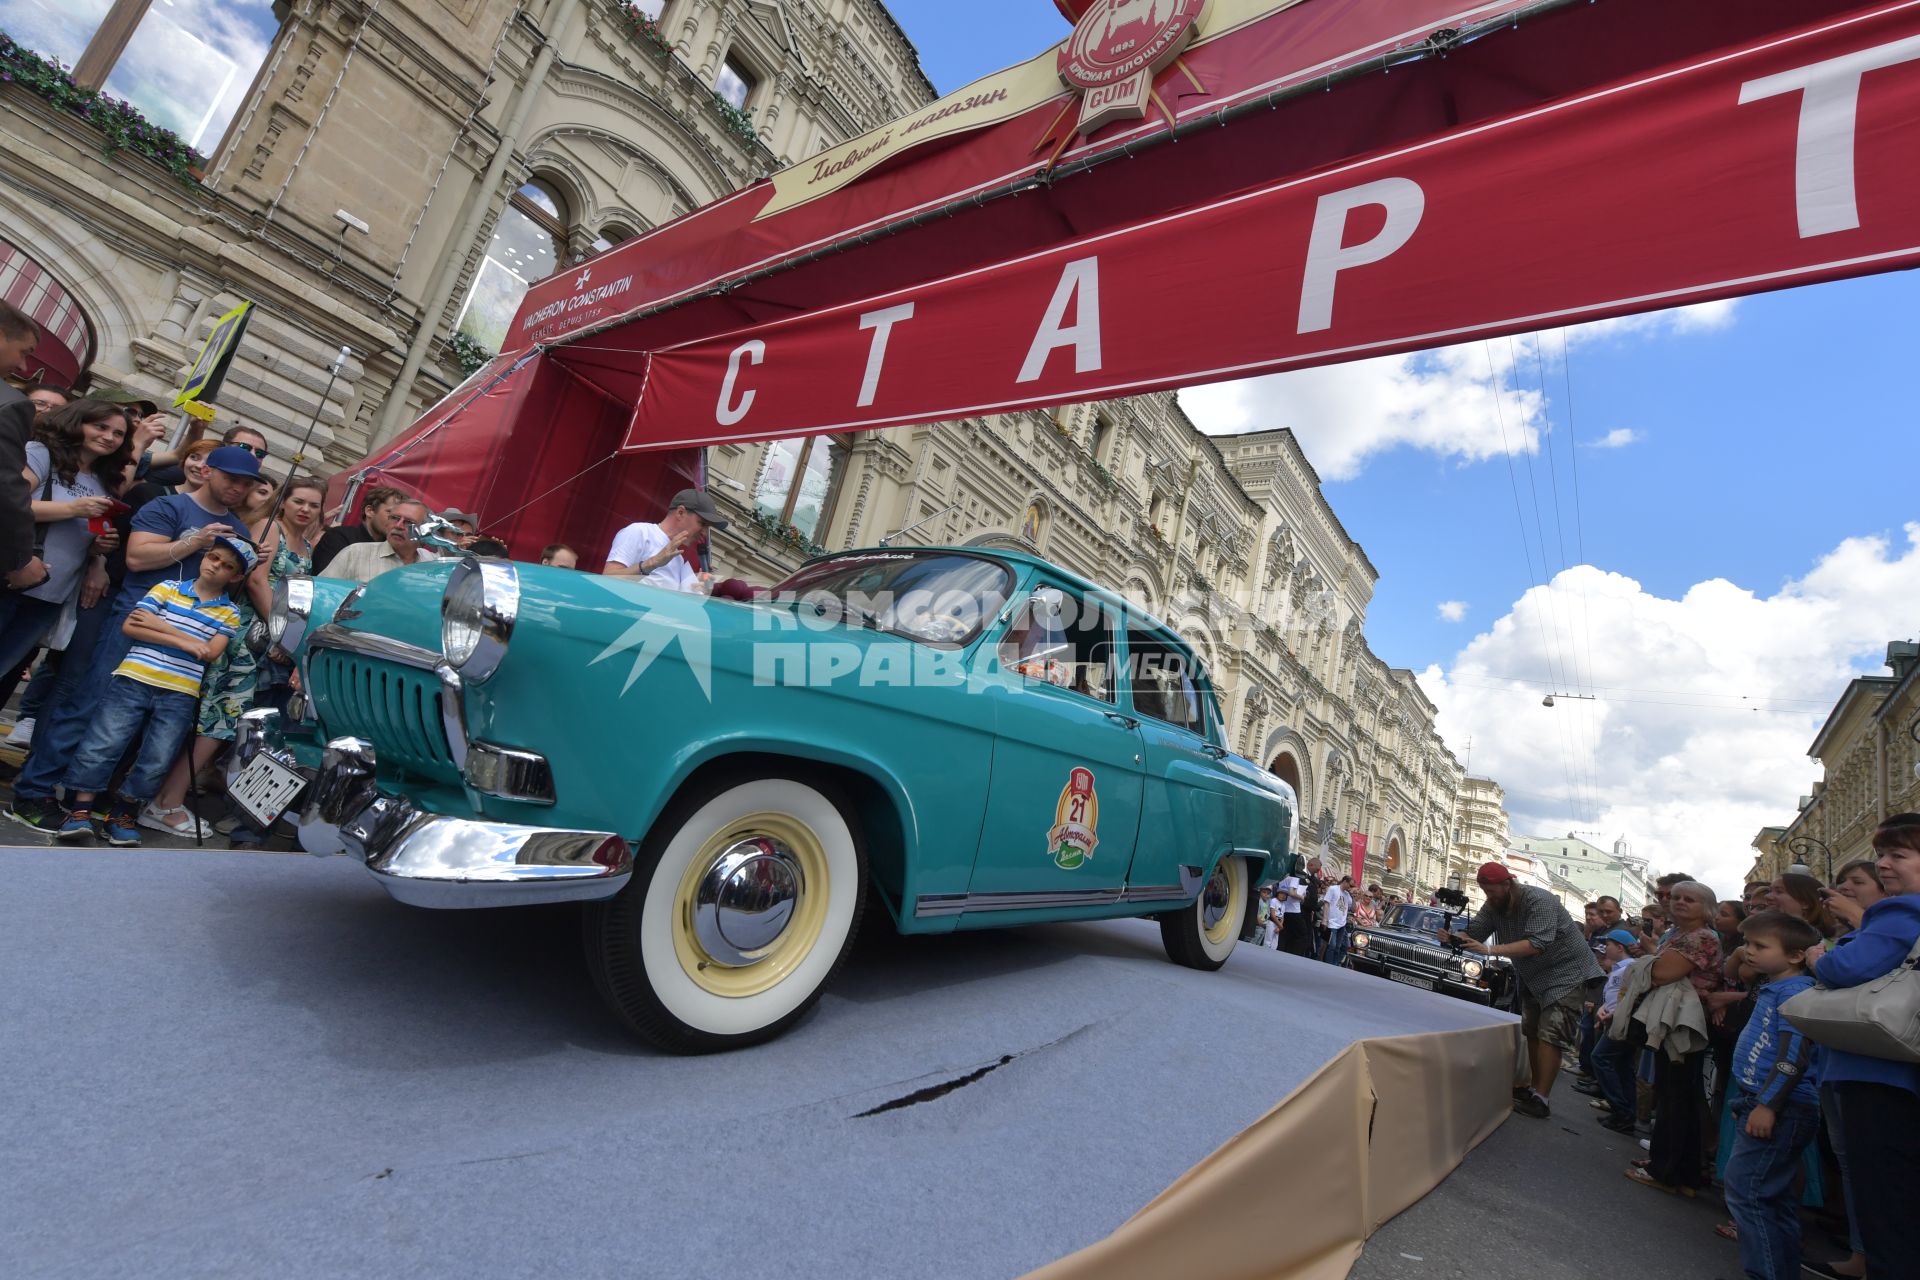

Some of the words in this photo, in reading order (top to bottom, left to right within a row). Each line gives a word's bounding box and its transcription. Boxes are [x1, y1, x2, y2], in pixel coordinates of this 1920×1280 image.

[1068, 61, 1113, 82] КРАСНАЯ
[1115, 22, 1181, 75] ПЛОЩАДЬ
[1110, 39, 1136, 55] 1893
[1090, 77, 1137, 109] GUM
[808, 129, 894, 184] Главный
[900, 88, 1008, 137] магазин
[523, 298, 568, 331] VACHERON
[568, 275, 633, 312] CONSTANTIN
[558, 314, 582, 331] DEPUIS
[1069, 797, 1086, 823] 21
